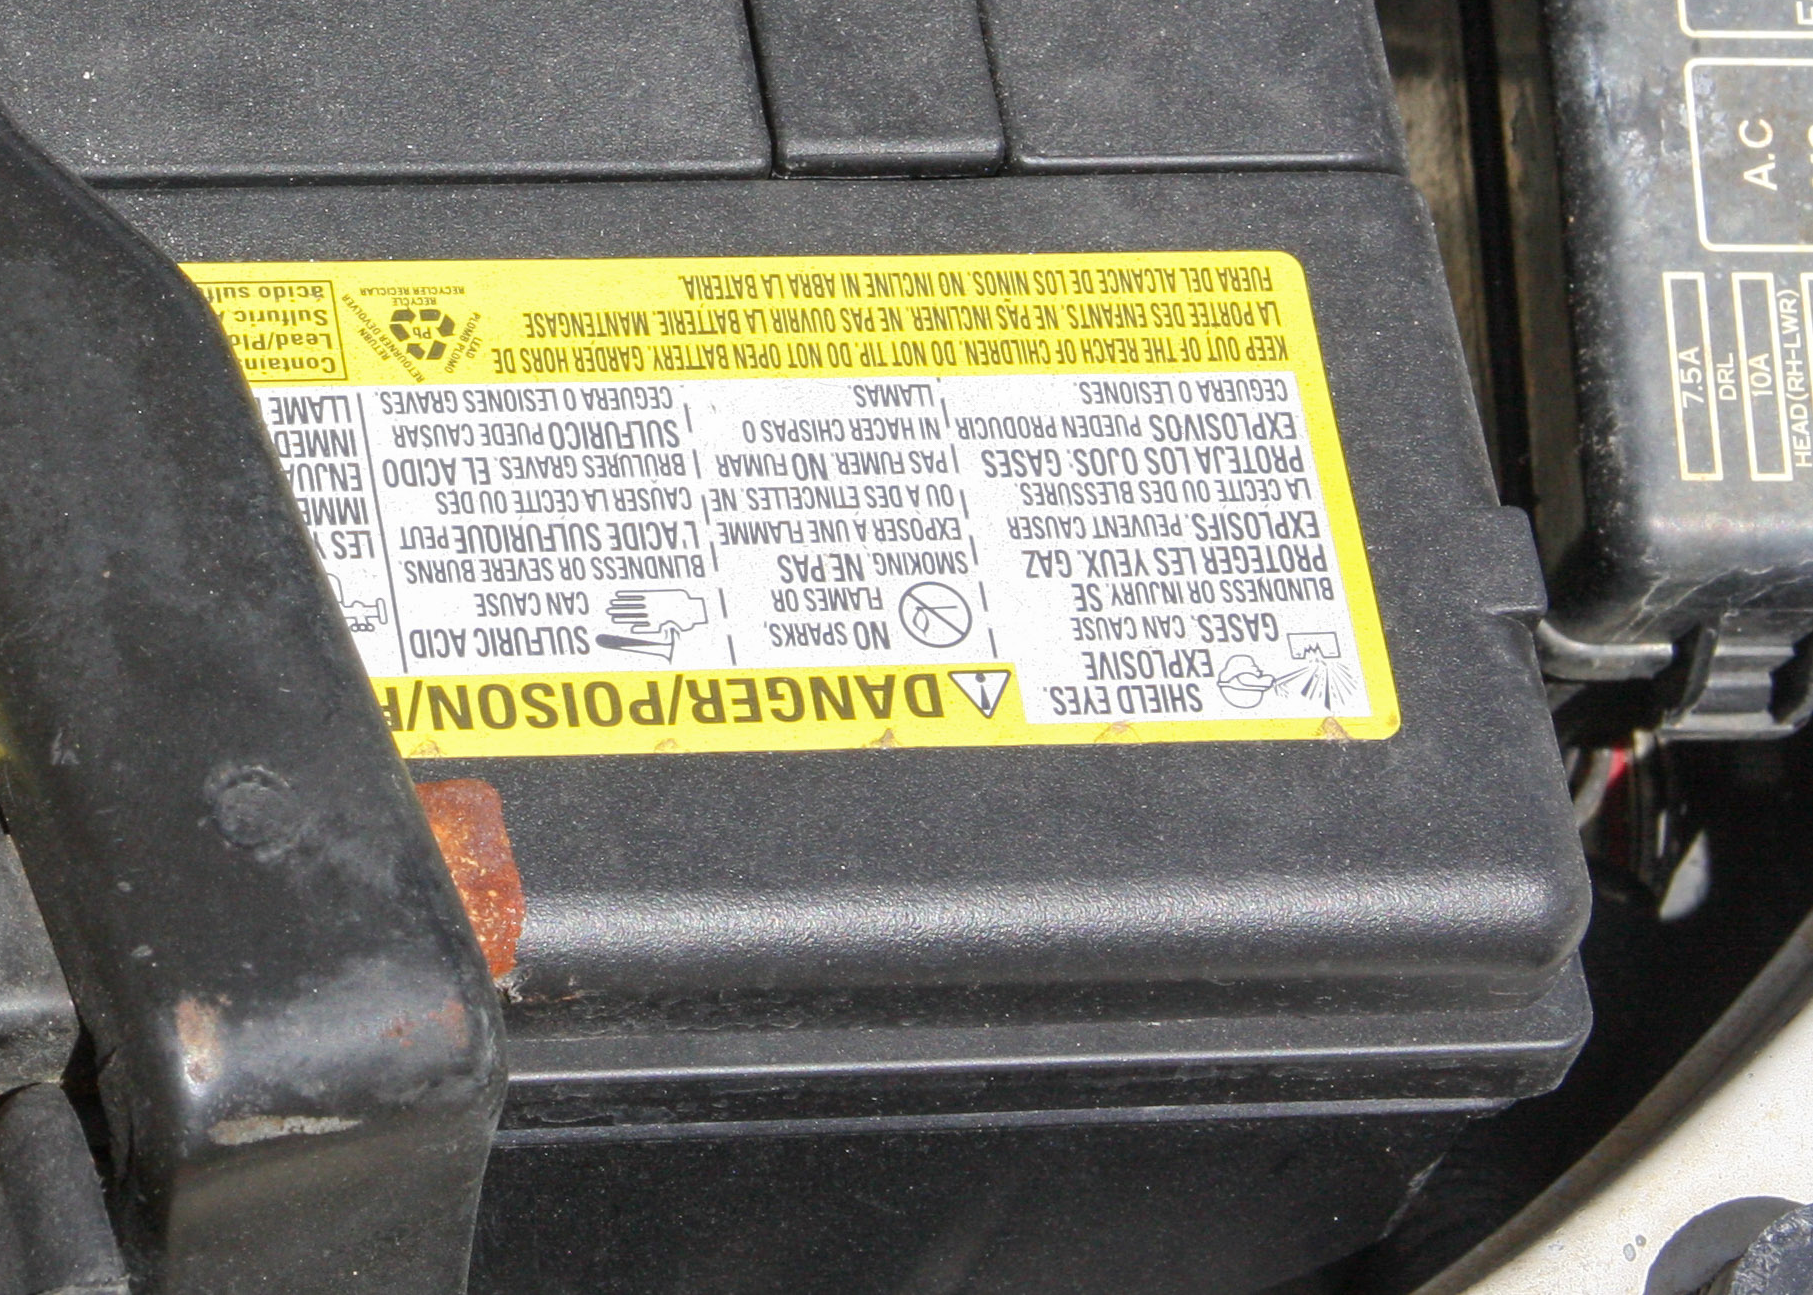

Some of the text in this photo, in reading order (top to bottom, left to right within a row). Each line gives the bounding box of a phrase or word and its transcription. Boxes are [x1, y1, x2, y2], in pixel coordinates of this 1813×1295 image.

[1739, 119, 1777, 191] A.C
[412, 327, 432, 339] Pb
[647, 335, 1288, 371] KEEP OUT OF THE REACH OF CHILDREN. DO NOT TIP. DO NOT OPEN BATTERY.
[1679, 346, 1704, 408] 7.5A
[1716, 352, 1737, 401] DRL
[1748, 353, 1774, 397] 10A
[1776, 289, 1813, 467] HEAD(RH-LWR)
[1073, 379, 1288, 404] CEGUERA O LESIONES.
[269, 395, 352, 424] LLAME
[955, 412, 1296, 441] EXPLOSIVOS PUEDEN PRODUCIR
[981, 445, 1304, 478] PROTEJA LOS OJOS: GASES
[1014, 480, 1133, 506] BLESSURES.
[1138, 480, 1176, 504] DES
[1181, 479, 1209, 503] OU
[1285, 478, 1311, 501] LA
[399, 520, 699, 554] L'ACIDE SULFURIQUE PEUT
[1006, 510, 1320, 540] EXPLOSIFS. PEUVENT CAUSER
[398, 555, 706, 584] BLINDNESS OR SEVERE BURNS.
[776, 551, 968, 583] SMOKING. NE PAS
[1021, 544, 1328, 578] PROTEGER LES YEUX. GAZ
[473, 592, 590, 617] CAN CAUSE
[770, 587, 883, 611] FLAMES OR
[1070, 577, 1334, 611] BLINDNESS OR INJURY. SE
[409, 626, 590, 659] SULFURIC ACID
[763, 621, 891, 650] NO SPARKS,
[1070, 613, 1279, 643] GASES. CAN CAUSE
[1081, 649, 1214, 680] EXPLOSIVE
[1042, 683, 1203, 716] SHIELD EYES.
